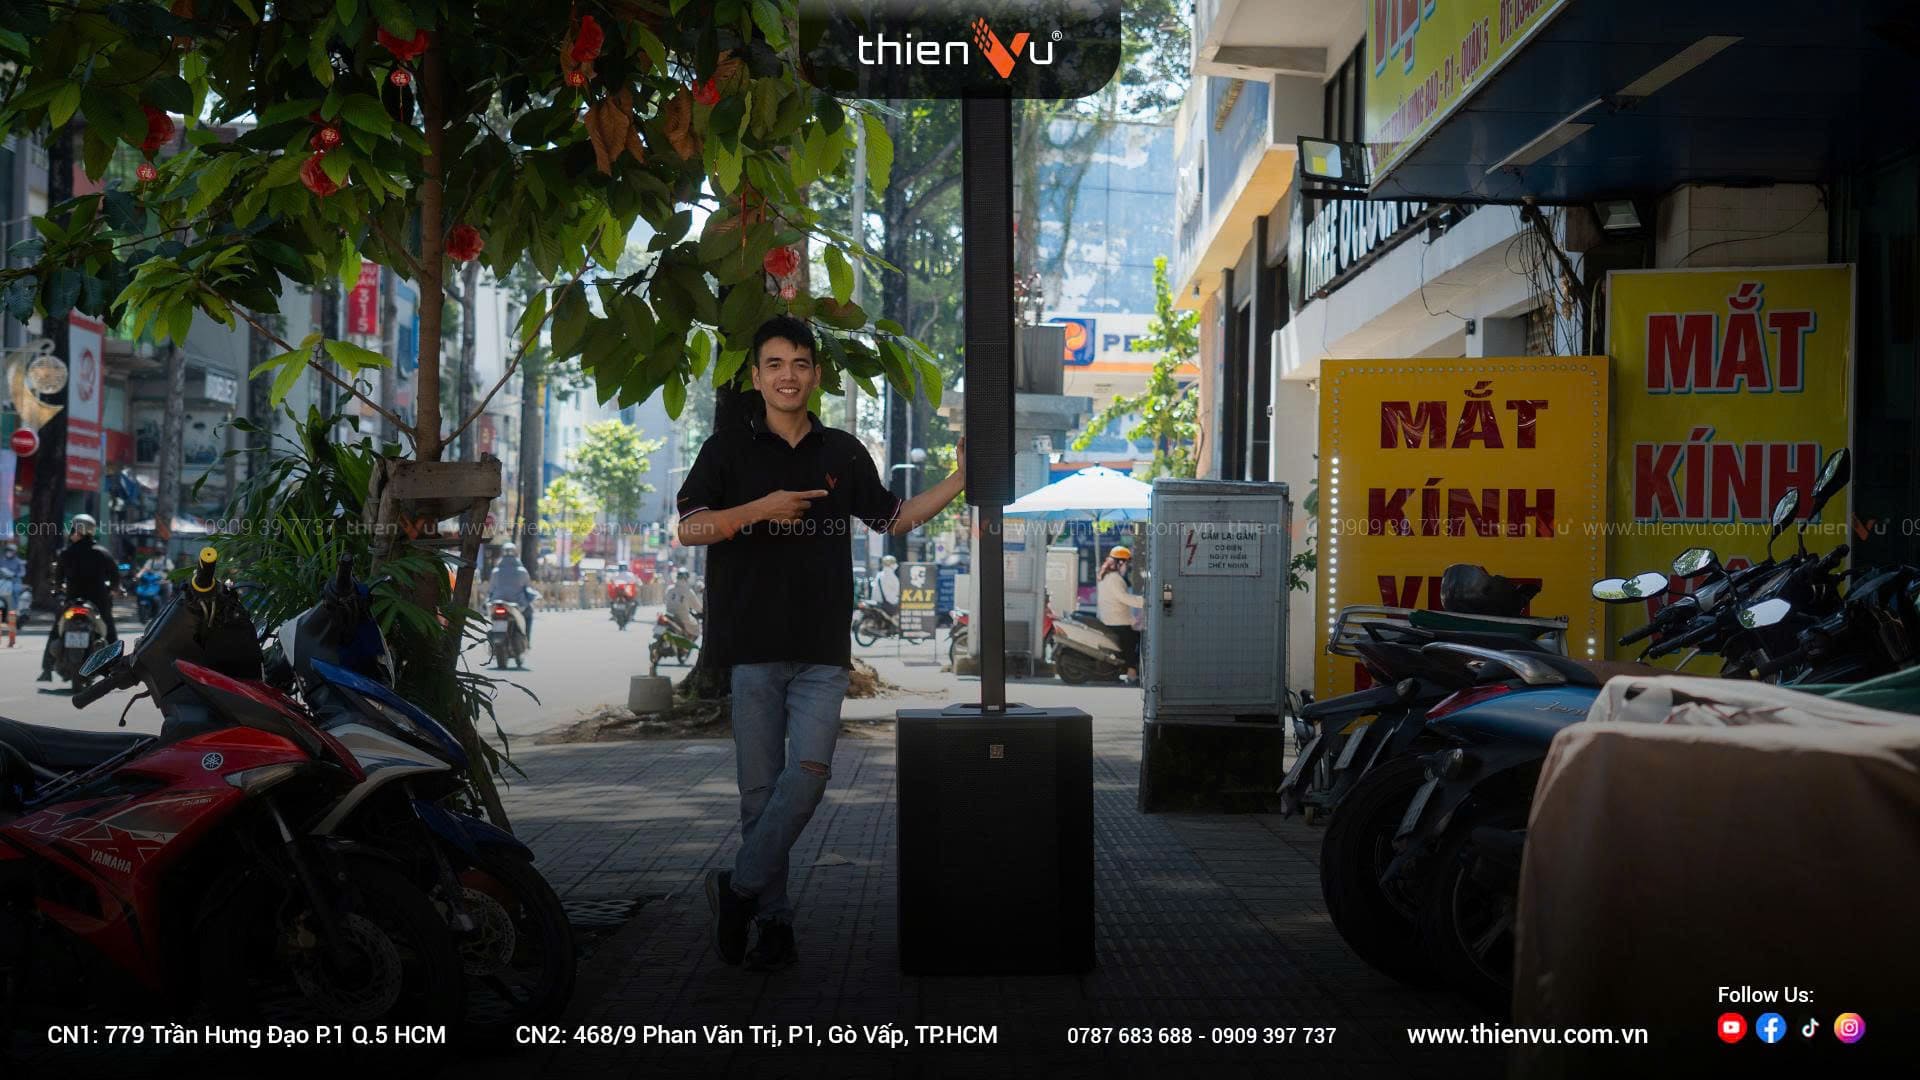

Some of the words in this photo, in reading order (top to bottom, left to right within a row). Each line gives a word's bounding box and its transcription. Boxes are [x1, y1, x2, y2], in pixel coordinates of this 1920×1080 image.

[1647, 283, 1814, 391] MẮT
[1380, 380, 1549, 449] MẮT
[1635, 427, 1819, 521] KÍNH
[1367, 477, 1556, 538] KÍNH
[901, 589, 936, 602] KAT
[90, 849, 133, 874] YAMAHA
